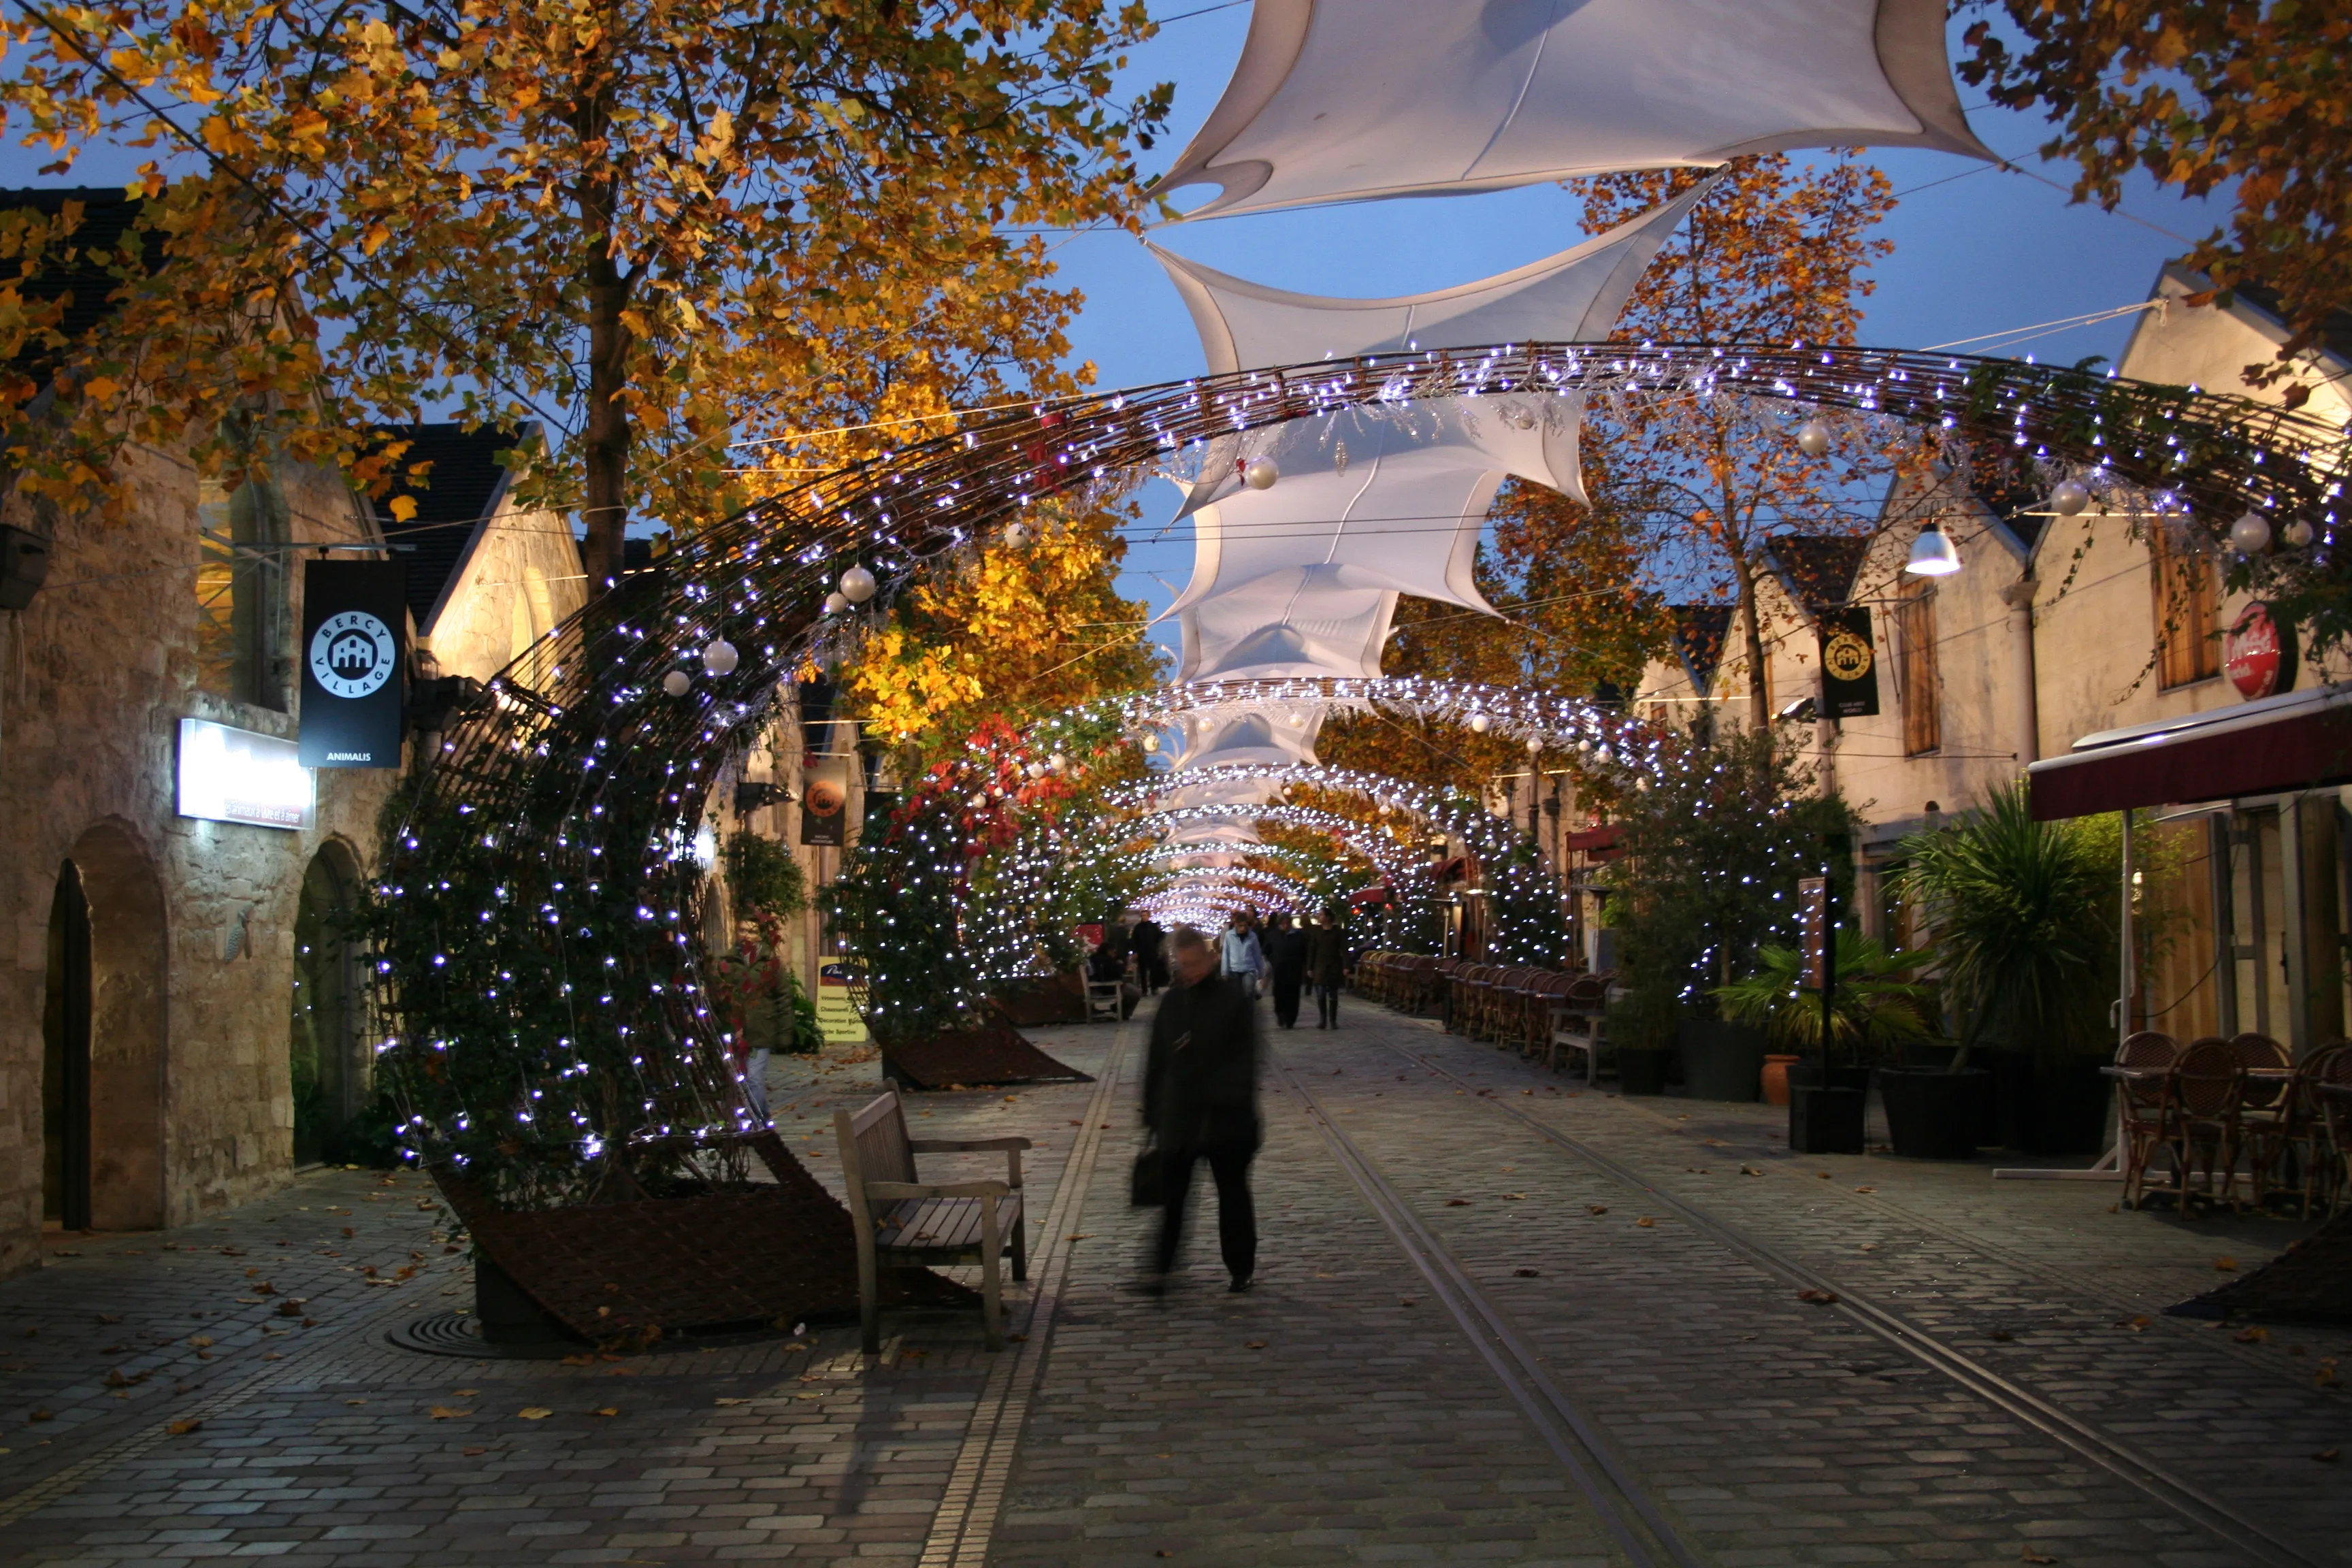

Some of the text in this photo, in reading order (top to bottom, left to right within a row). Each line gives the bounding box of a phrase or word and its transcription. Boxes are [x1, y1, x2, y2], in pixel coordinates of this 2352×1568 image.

[322, 615, 387, 639] BERCY
[316, 657, 390, 693] VILLAGE
[327, 752, 372, 762] ANIMALIS
